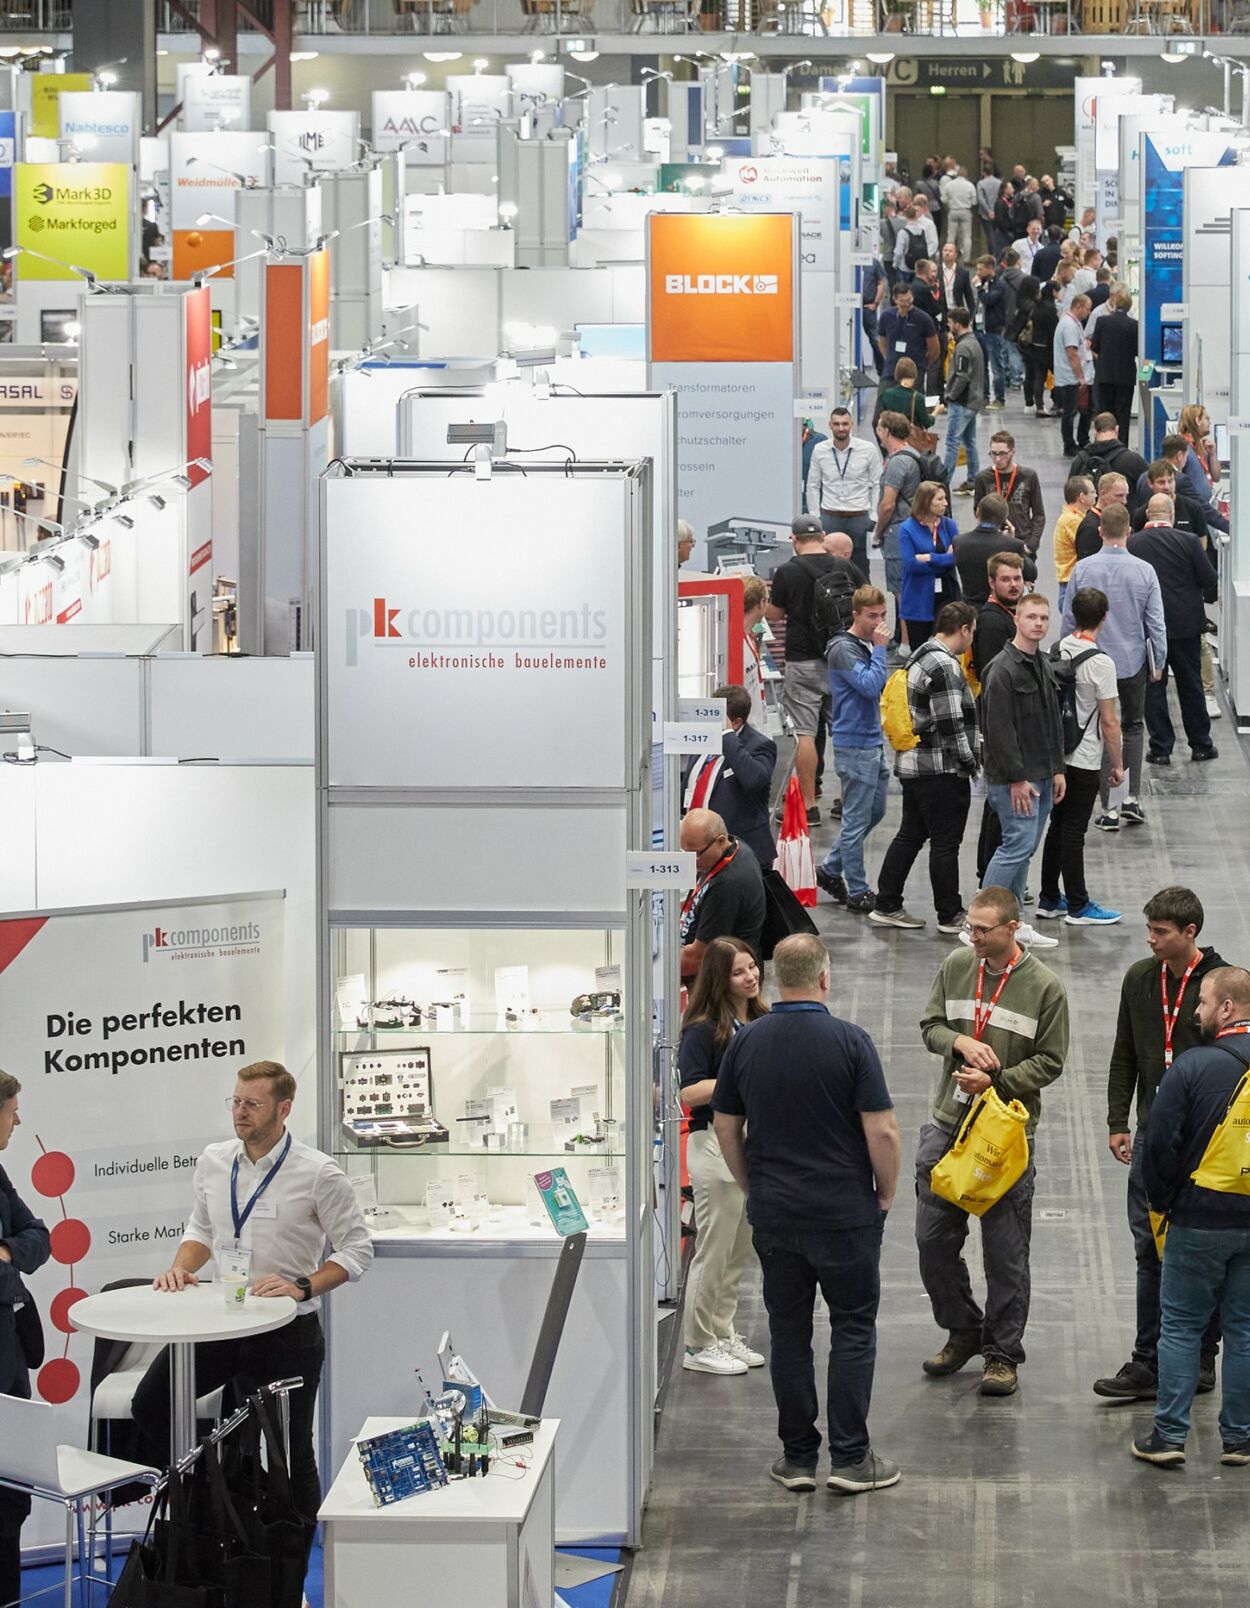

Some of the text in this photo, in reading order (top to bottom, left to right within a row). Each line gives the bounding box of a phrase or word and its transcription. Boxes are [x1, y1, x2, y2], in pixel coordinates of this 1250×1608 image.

[929, 64, 977, 76] Herren
[65, 122, 129, 134] Nabtesco
[177, 177, 239, 188] Weidmülle
[47, 216, 117, 233] Markforged
[665, 275, 752, 294] BLOCK
[666, 383, 757, 394] Transformatoren
[678, 409, 775, 422] romversorgungen
[678, 435, 747, 446] hutzschalter
[678, 461, 716, 472] osseln
[408, 652, 606, 668] elektronische bauelemente
[695, 709, 720, 717] 1-319
[683, 735, 708, 743] 1-317
[649, 865, 680, 873] 1-313
[171, 946, 260, 961] elektronische bauelemente
[47, 1000, 242, 1040] Die perfekten
[44, 1039, 245, 1074] Komponenten
[94, 1156, 169, 1177] Individuelle
[108, 1227, 150, 1245] Starke
